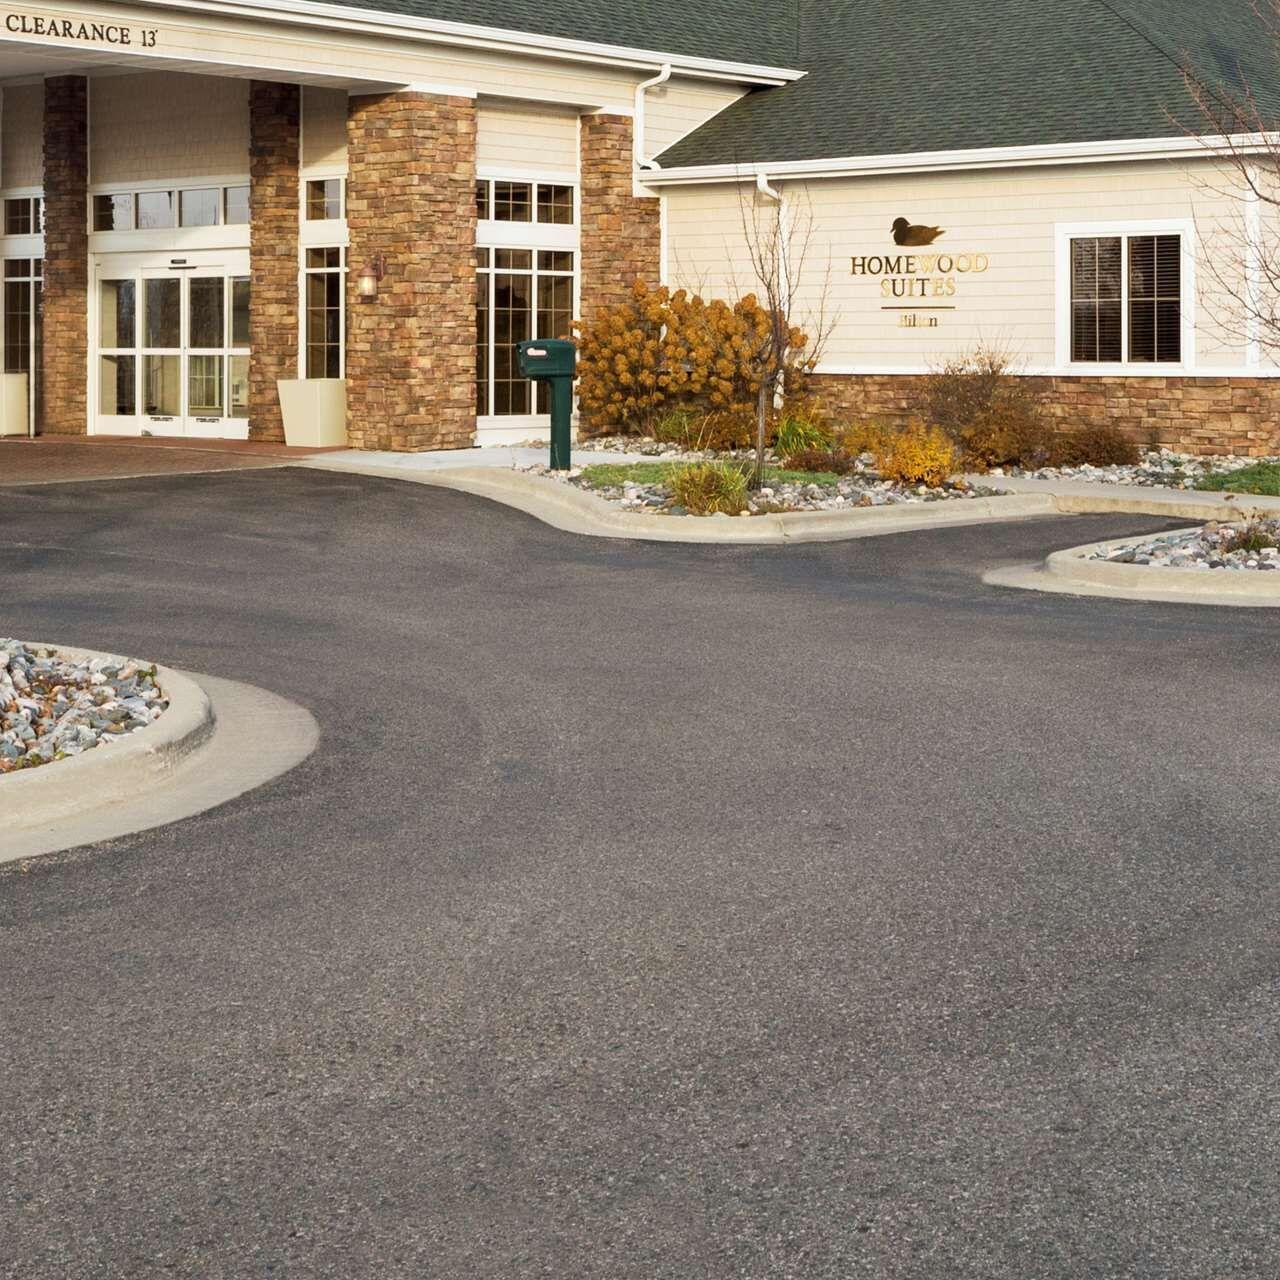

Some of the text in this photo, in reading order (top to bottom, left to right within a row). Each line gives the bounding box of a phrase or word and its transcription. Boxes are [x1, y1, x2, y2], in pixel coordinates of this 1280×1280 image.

[5, 14, 131, 45] CLEARANCE
[850, 254, 989, 275] HOMEWOOD
[880, 277, 956, 297] SUITES
